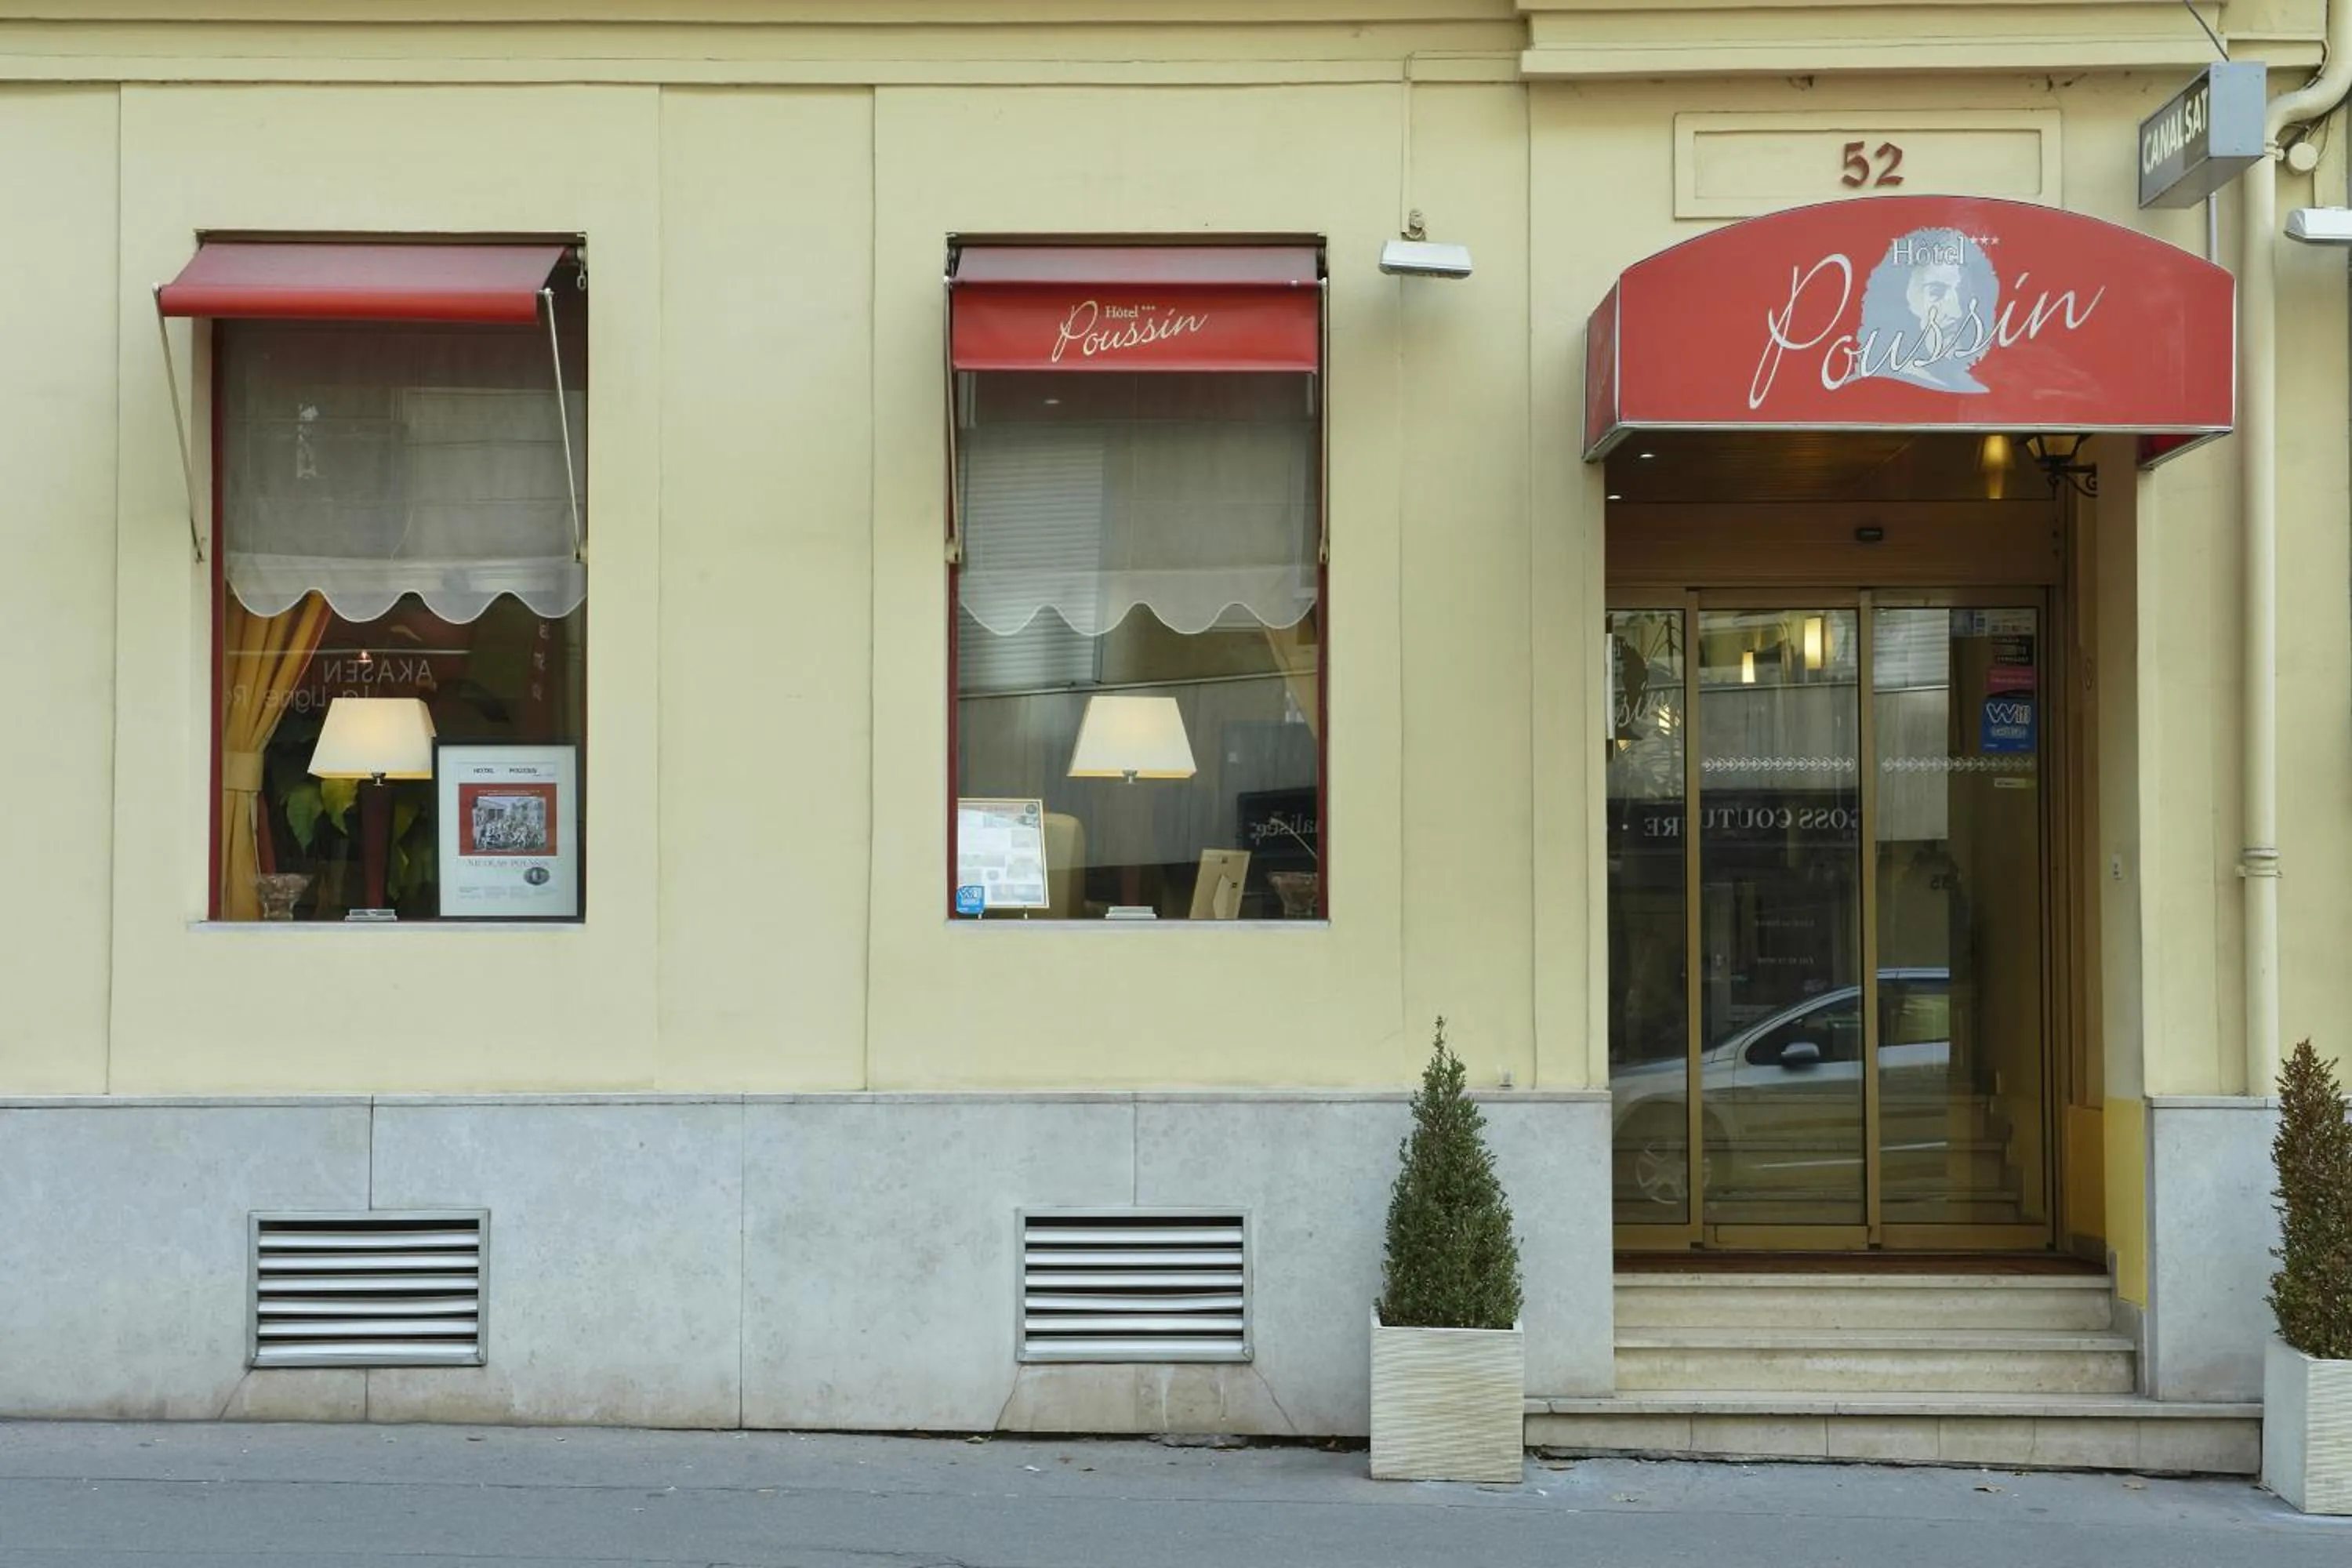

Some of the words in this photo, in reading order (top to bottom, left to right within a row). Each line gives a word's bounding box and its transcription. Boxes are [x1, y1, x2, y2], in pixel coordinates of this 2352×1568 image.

[1842, 140, 1904, 187] 52
[1891, 235, 1965, 265] Hôtel
[1051, 300, 1209, 362] Poussin
[1105, 303, 1138, 318] Hôtel
[1749, 253, 2107, 409] Poussin
